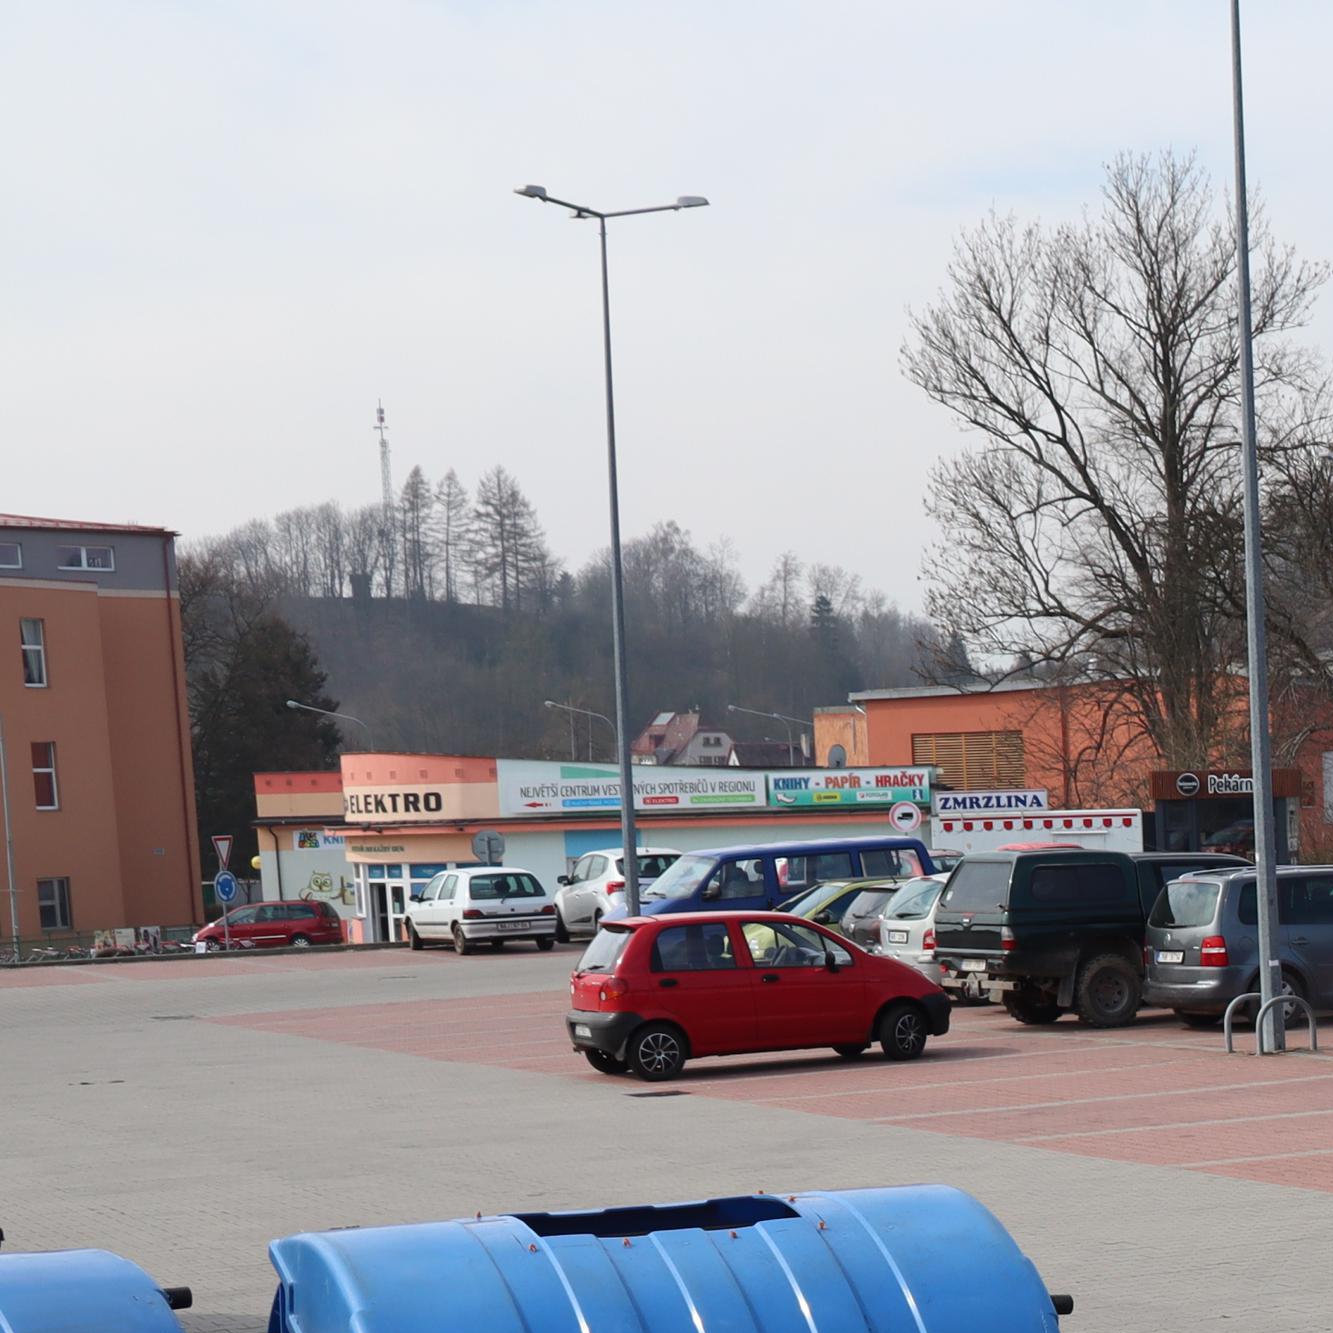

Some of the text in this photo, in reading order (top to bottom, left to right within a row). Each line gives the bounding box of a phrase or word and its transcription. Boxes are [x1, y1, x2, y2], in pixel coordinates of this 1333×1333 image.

[520, 778, 756, 798] NEJVĚTŠÍ CENTRUM VESTNÝCH SPOTŘEBIČŮ V REGIONU
[773, 777, 811, 790] KNIHY
[824, 773, 862, 789] PAPÍR
[875, 771, 925, 788] HRAČKY
[1208, 773, 1254, 794] Pekárn
[349, 792, 443, 814] ELEKTRO
[939, 794, 1044, 810] ZMRZLINA
[323, 835, 345, 846] KNI
